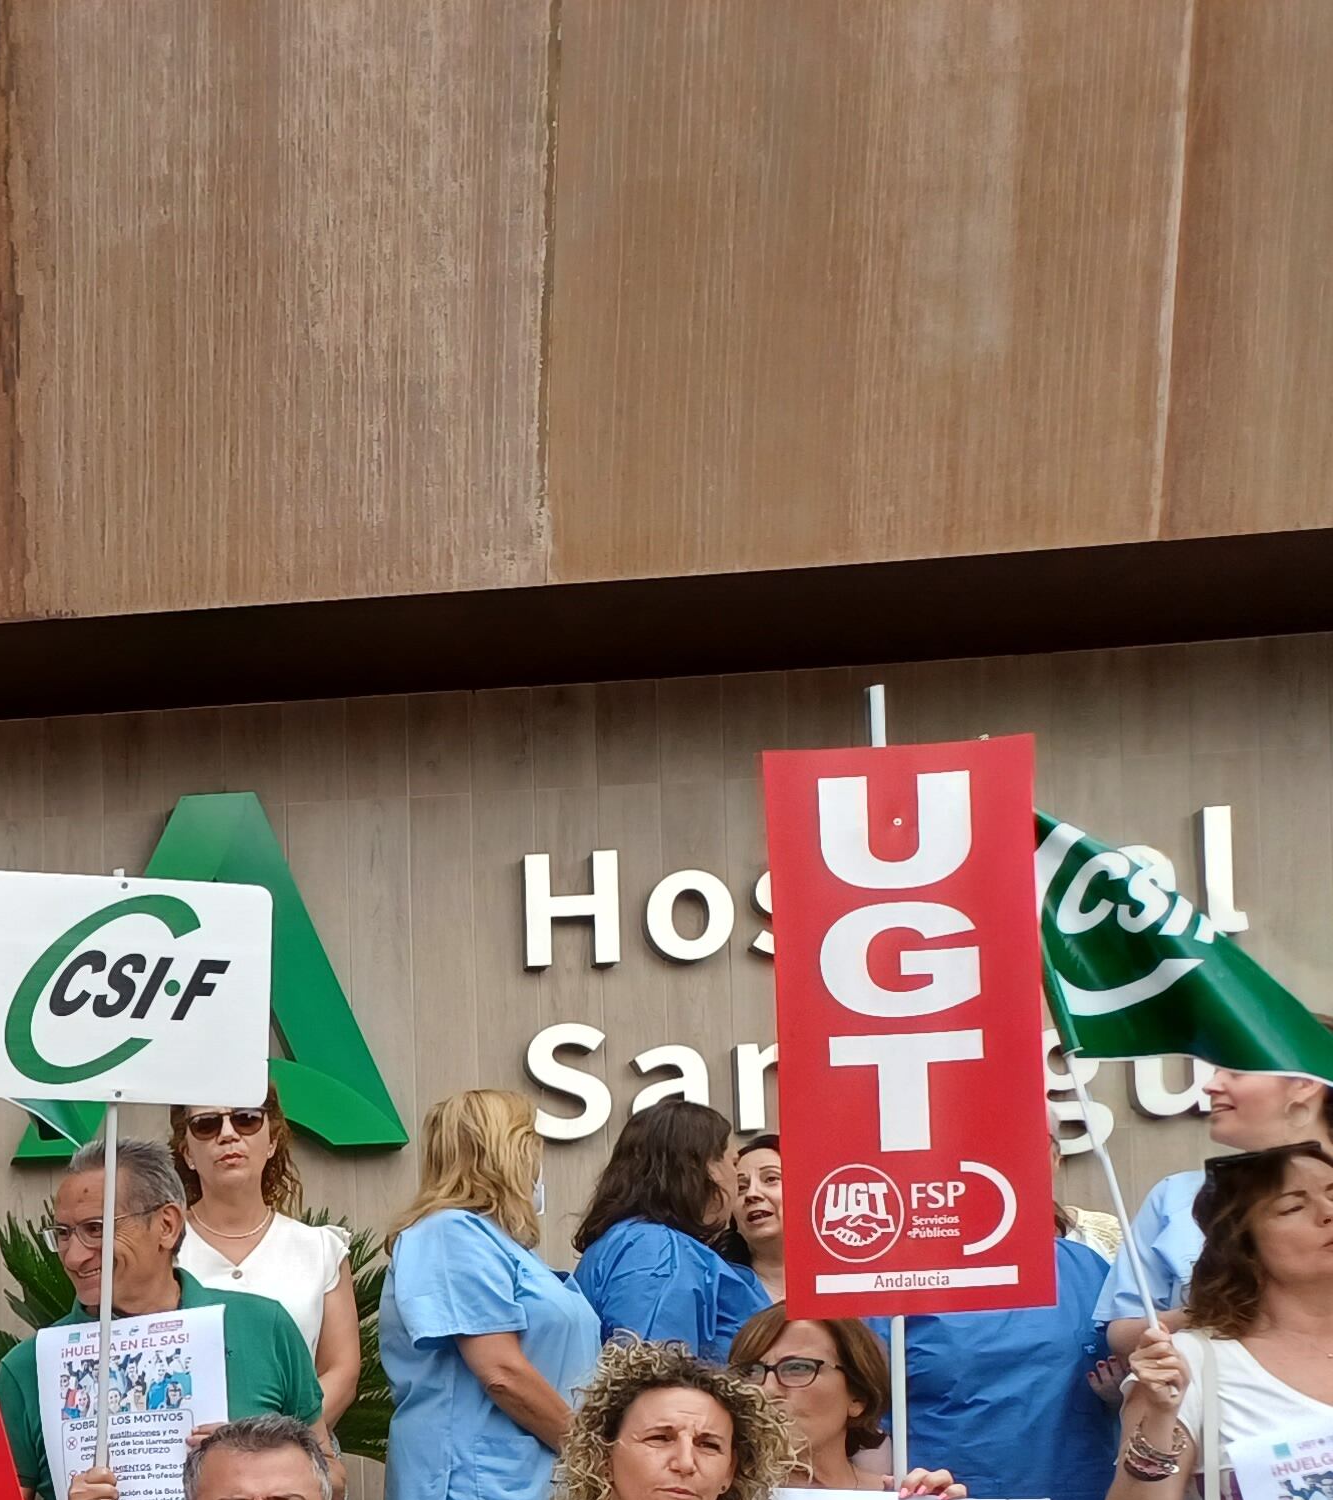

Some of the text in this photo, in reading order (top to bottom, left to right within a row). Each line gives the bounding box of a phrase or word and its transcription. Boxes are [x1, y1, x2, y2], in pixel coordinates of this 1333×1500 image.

[816, 769, 983, 1153] UGT
[826, 1182, 888, 1219] UGT
[910, 1181, 966, 1209] FSP
[912, 1214, 960, 1225] Servicios
[61, 1333, 190, 1358] ¡HUELA EN EL SAS!
[111, 1412, 183, 1426] LOS MOTIVOS
